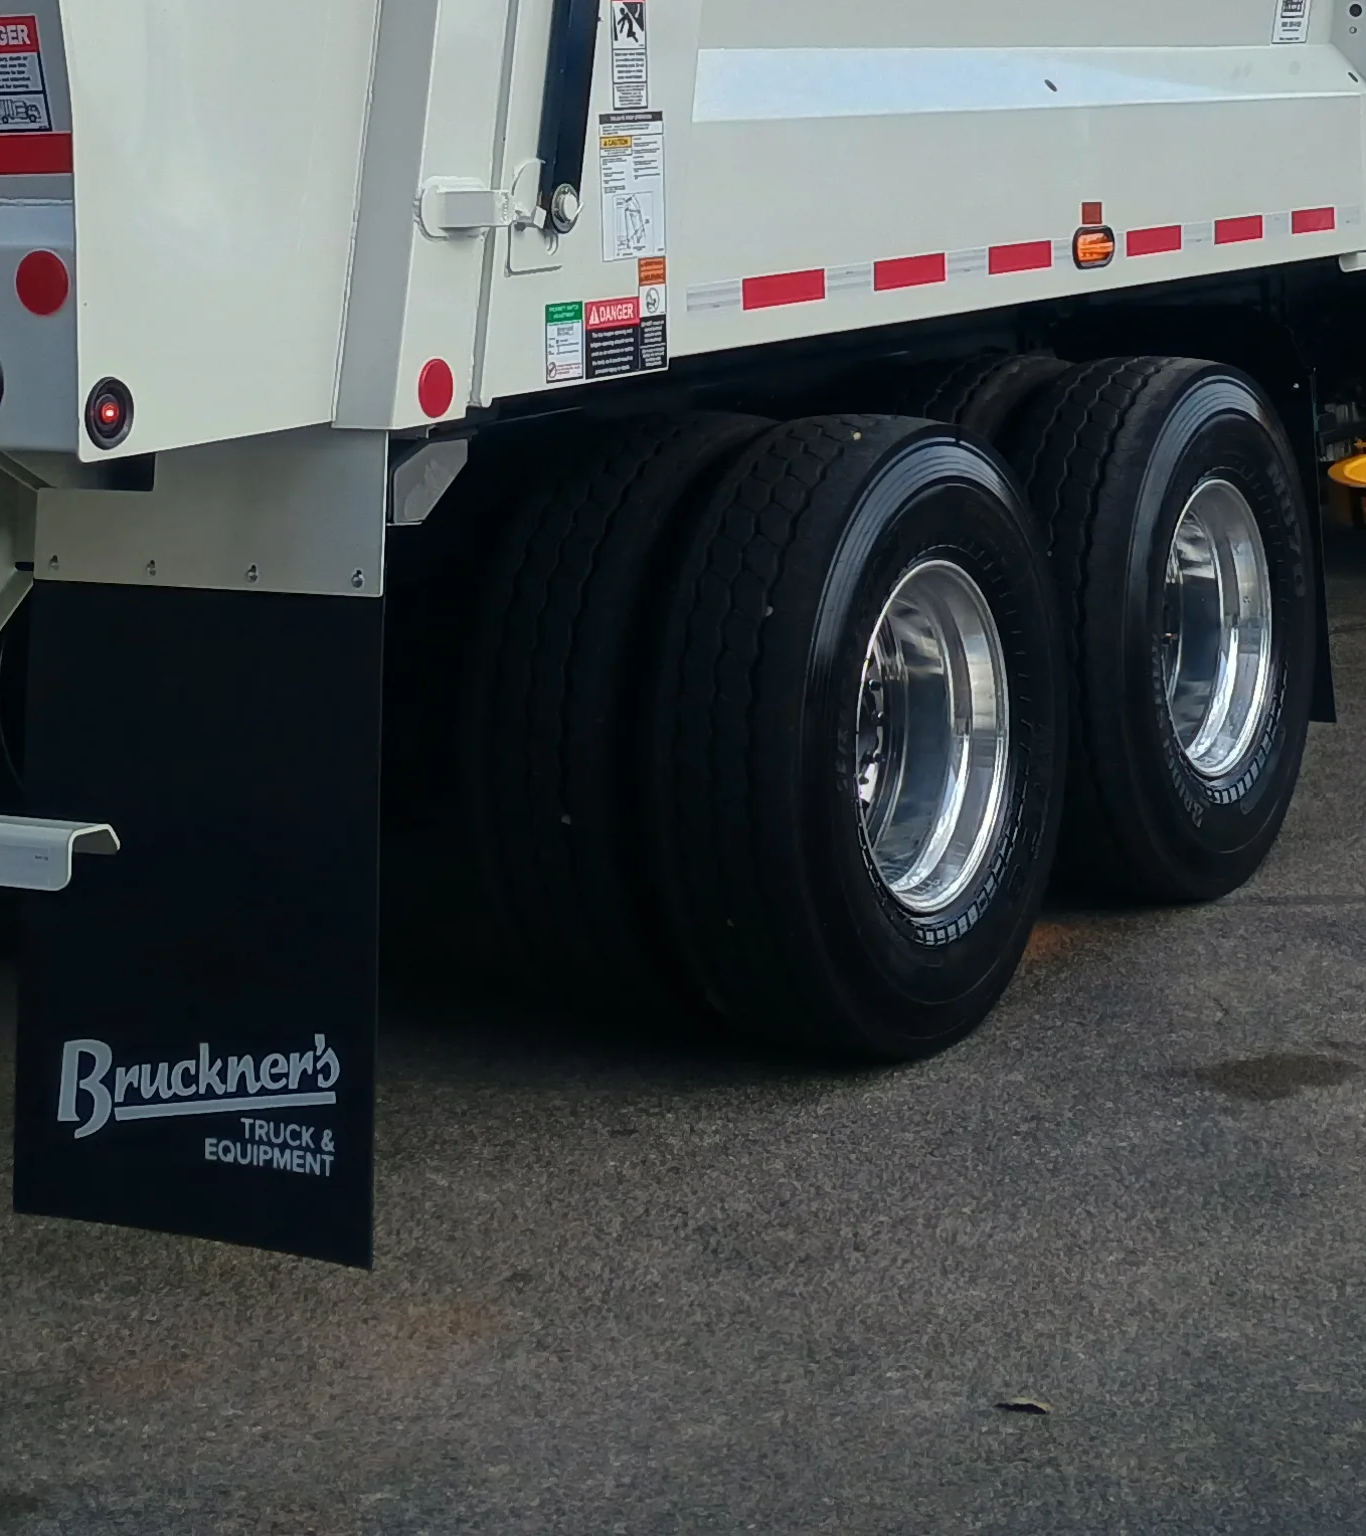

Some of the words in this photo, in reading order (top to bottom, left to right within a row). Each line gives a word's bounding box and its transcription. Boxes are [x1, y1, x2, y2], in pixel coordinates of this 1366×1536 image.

[599, 303, 634, 322] DANGER
[57, 1033, 341, 1139] Bruckner's
[240, 1117, 315, 1149] TRUCK
[321, 1128, 335, 1152] &
[204, 1137, 335, 1177] EQUIPMENT
